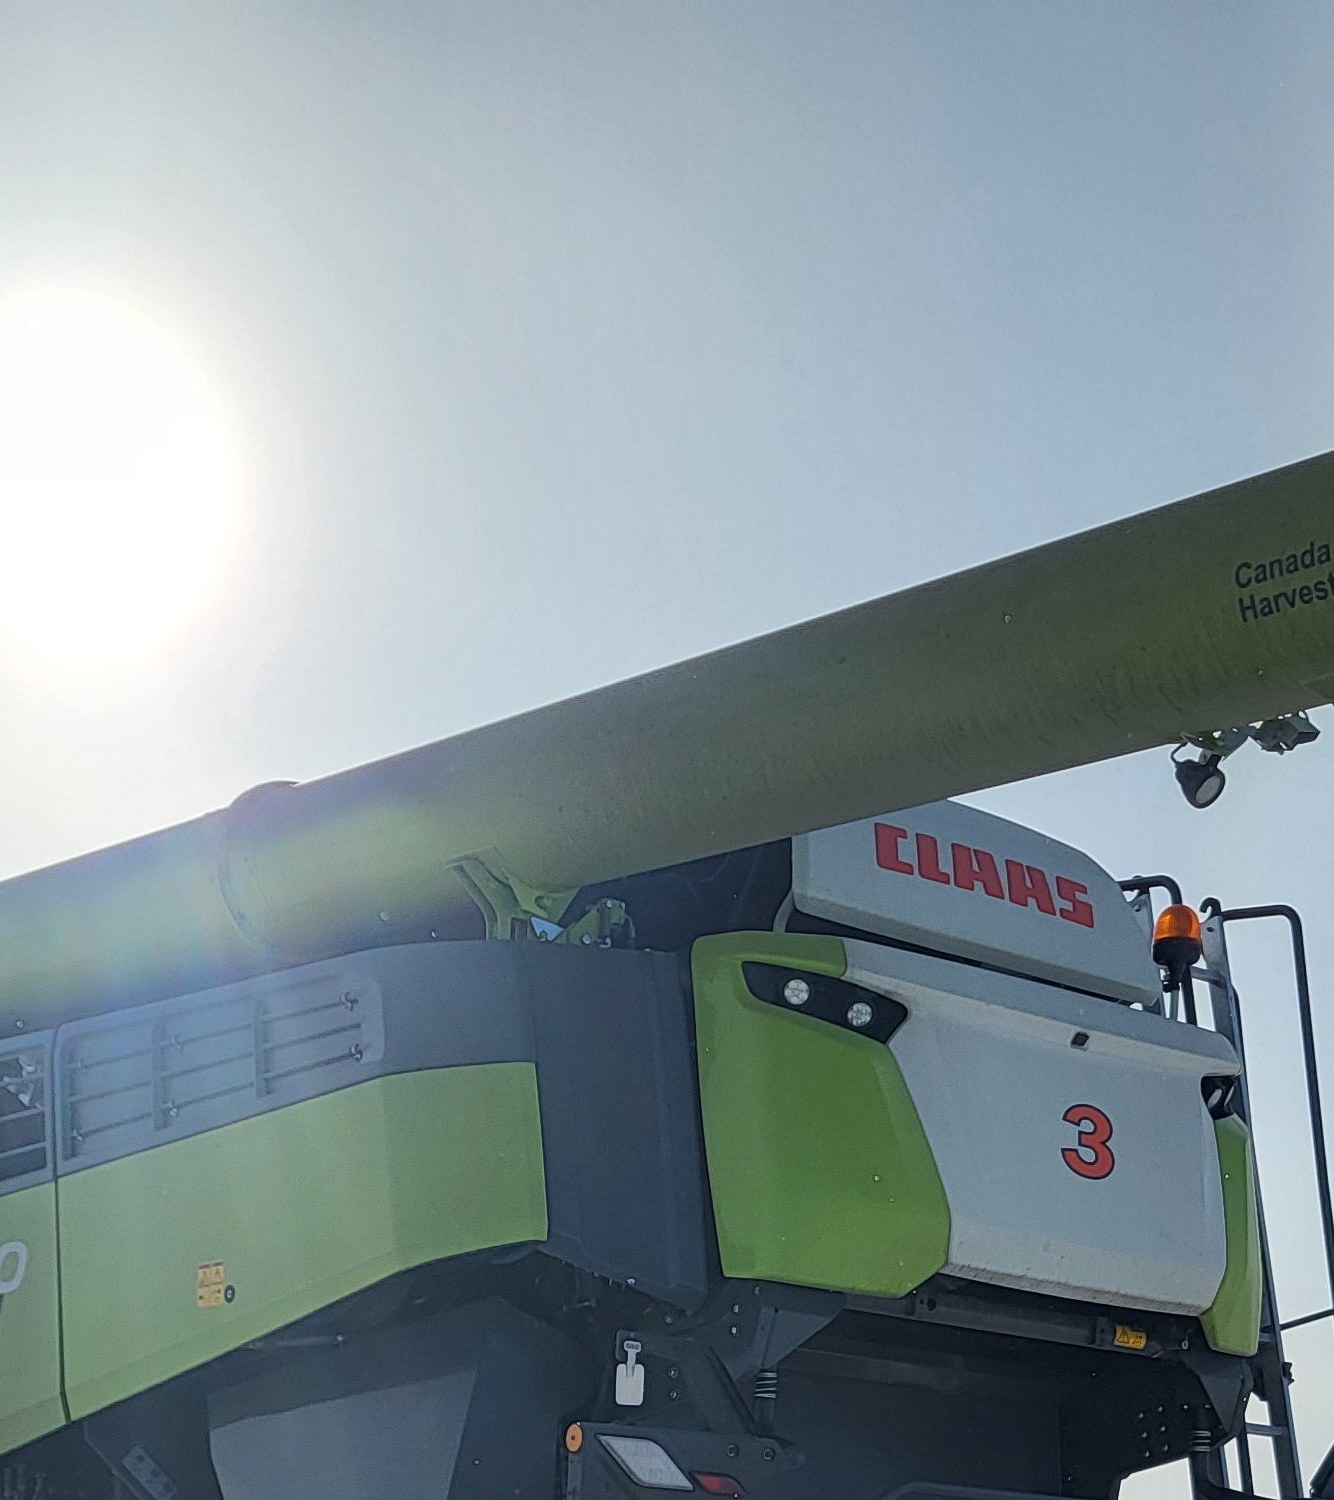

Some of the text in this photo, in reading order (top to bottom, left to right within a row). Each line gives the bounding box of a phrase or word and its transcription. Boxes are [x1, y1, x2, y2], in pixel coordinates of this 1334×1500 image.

[1235, 541, 1331, 588] Canada
[873, 822, 1095, 928] CLAAS
[1060, 1103, 1116, 1180] 3
